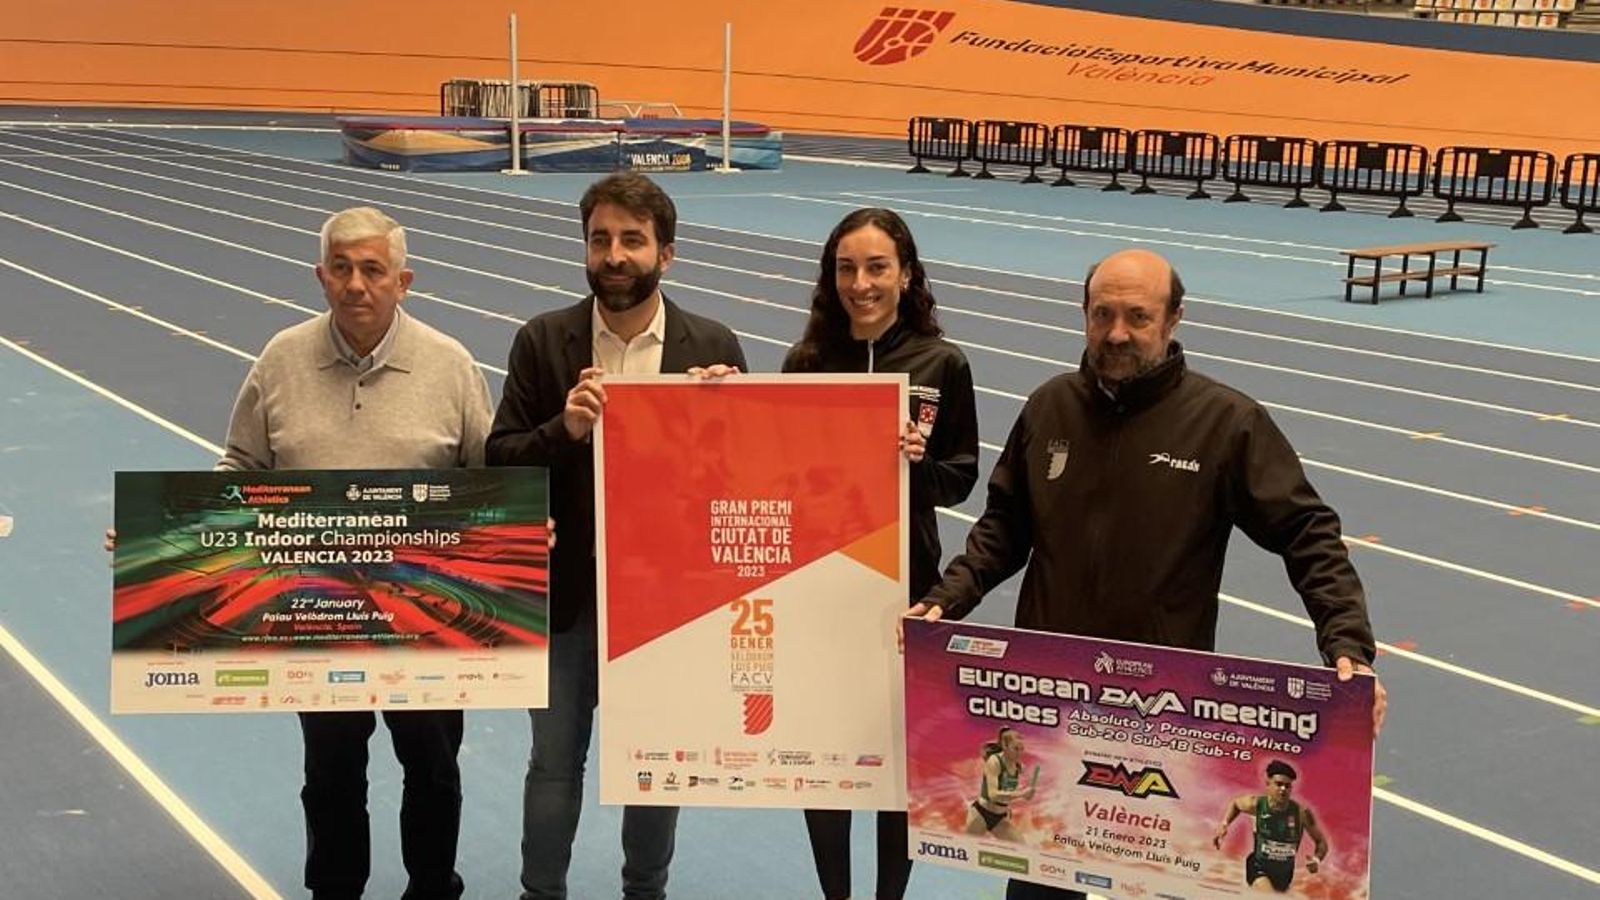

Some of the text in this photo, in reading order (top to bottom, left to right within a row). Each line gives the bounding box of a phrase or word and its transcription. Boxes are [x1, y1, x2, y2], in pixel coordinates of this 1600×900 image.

[1067, 62, 1215, 87] València
[1088, 46, 1240, 72] Esportiva
[1238, 60, 1411, 84] Municipal
[243, 485, 312, 494] Mediterranean
[711, 500, 792, 515] GRAN PREMI
[258, 512, 408, 528] Mediterranean
[711, 516, 792, 527] INTERNACIONAL
[201, 529, 461, 547] U23 Indoor Championships
[711, 528, 792, 545] CIUTAT DE
[261, 550, 394, 564] VALENCIA 2023
[737, 565, 766, 577] 2023
[313, 599, 365, 610] January
[262, 612, 292, 622] Palau
[371, 611, 394, 622] Puig
[730, 599, 774, 637] 25
[730, 637, 774, 649] GENER
[959, 667, 1318, 739] European DNA meeting
[968, 697, 1059, 725] clubes
[1069, 709, 1302, 754] Absoluto y Promoción Mixto
[1069, 723, 1252, 761] Sub-20 Sub-18 Sub-16
[1082, 763, 1175, 797] DNA
[1084, 800, 1171, 832] València
[1085, 825, 1167, 849] 21 Enero 2023
[1054, 833, 1086, 848] Palau
[1174, 856, 1201, 872] Puig
